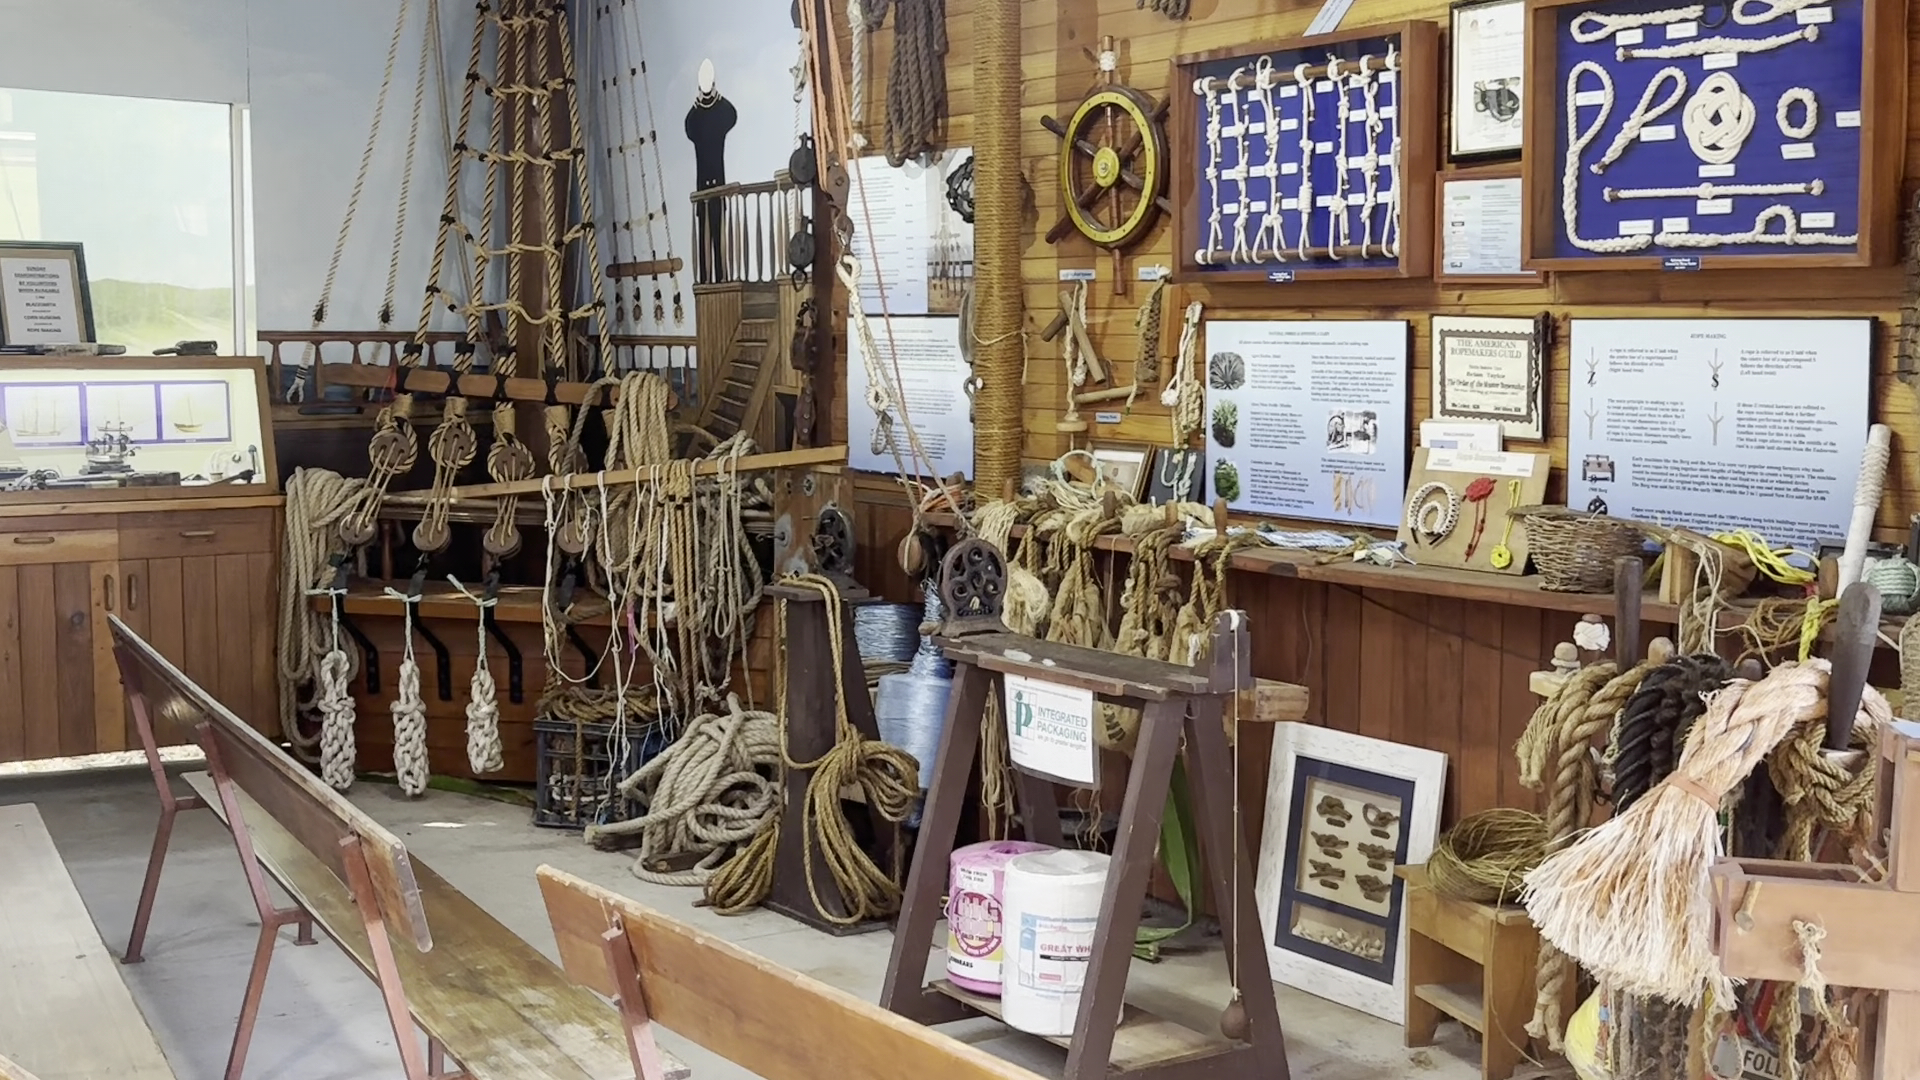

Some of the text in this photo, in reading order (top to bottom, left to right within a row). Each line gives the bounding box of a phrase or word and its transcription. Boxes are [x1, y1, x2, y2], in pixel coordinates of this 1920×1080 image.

[1456, 339, 1516, 349] THE AMERICAN
[1450, 348, 1522, 359] ROPEMAKERS GUILD
[1038, 706, 1088, 728] INTEGRATED
[1037, 721, 1087, 743] PACKAGING
[1040, 944, 1091, 953] GREAT WH
[1743, 1049, 1782, 1078] FOLL
